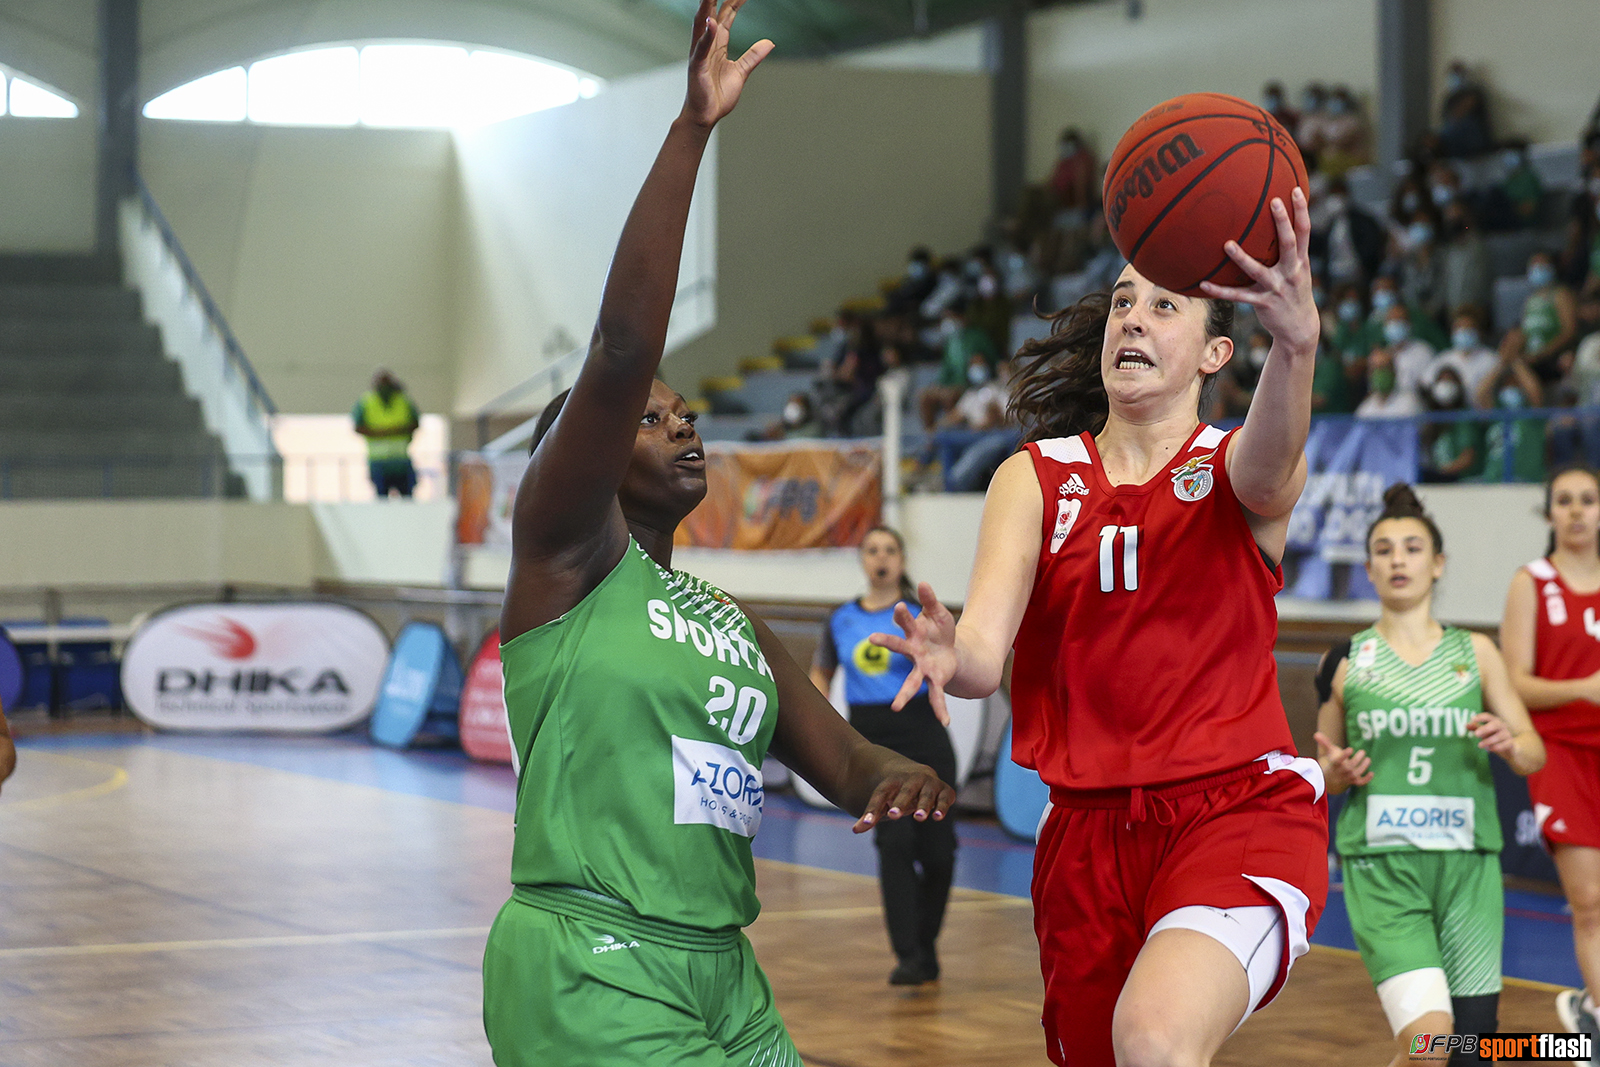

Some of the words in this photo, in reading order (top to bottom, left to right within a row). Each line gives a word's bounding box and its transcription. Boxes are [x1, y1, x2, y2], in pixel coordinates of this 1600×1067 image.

[1108, 132, 1206, 233] Wilson
[1058, 482, 1090, 497] adidas
[1098, 525, 1139, 592] 11
[157, 667, 350, 695] DHIKA
[704, 675, 768, 746] 20
[1407, 746, 1435, 786] 5
[1376, 808, 1466, 828] AZORIS
[592, 940, 640, 955] DHIKA
